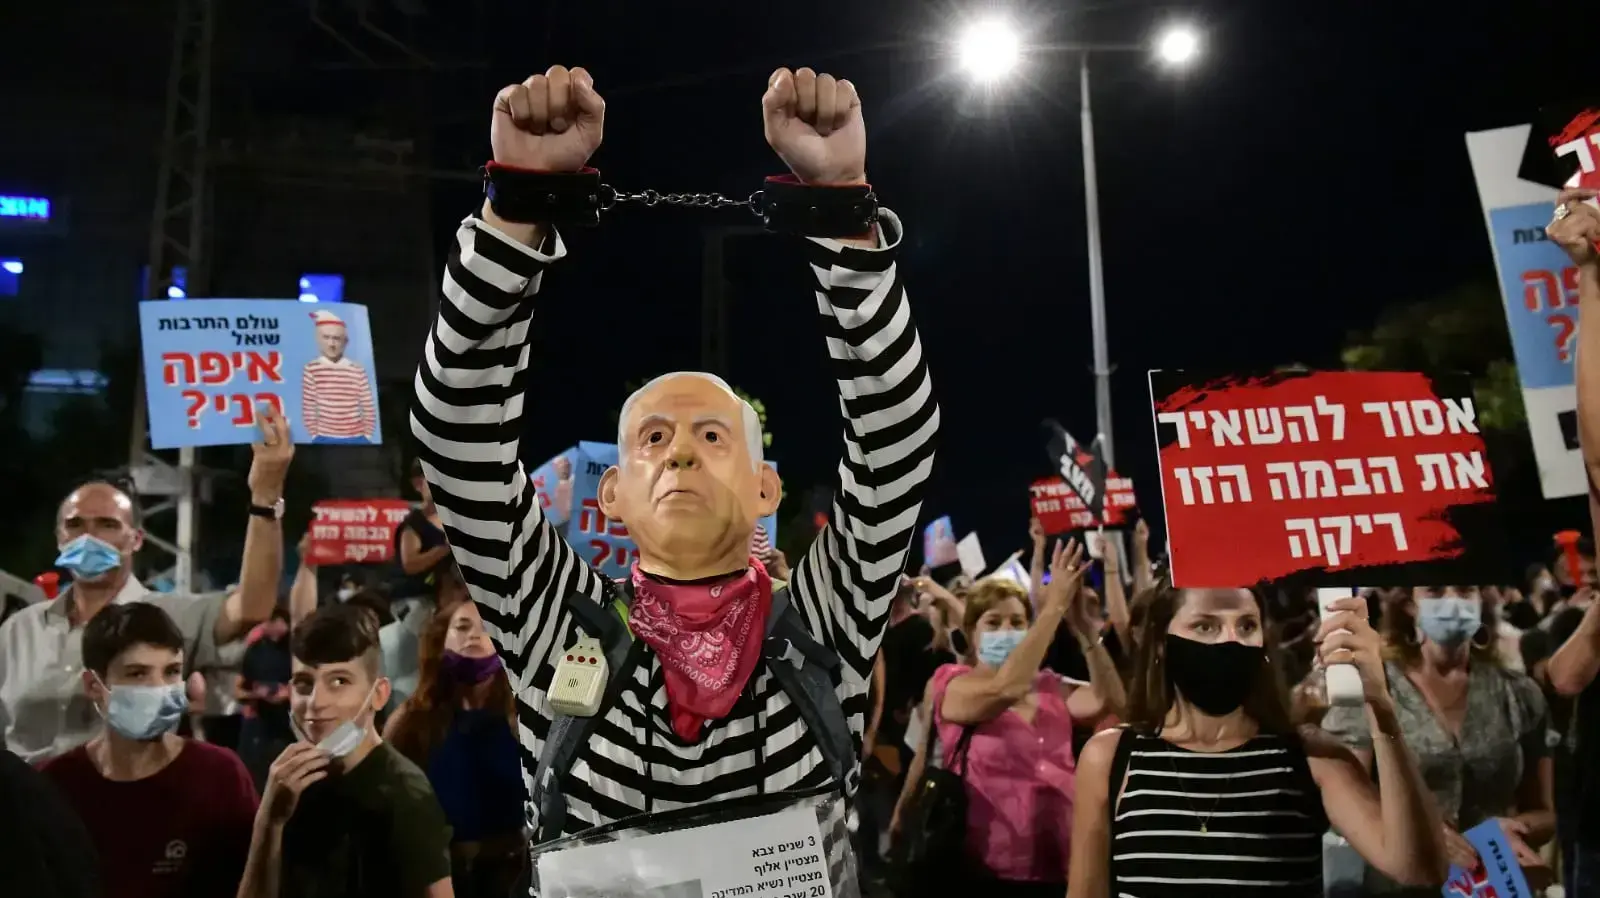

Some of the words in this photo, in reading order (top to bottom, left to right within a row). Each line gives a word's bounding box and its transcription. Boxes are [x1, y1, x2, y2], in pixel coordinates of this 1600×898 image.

[158, 317, 230, 330] התרבות
[236, 314, 279, 330] עולם
[231, 330, 281, 346] שואל
[161, 350, 284, 386] איפה
[1157, 395, 1345, 449] להשאיר
[1362, 397, 1480, 438] אסור
[1266, 456, 1404, 500] הבמה
[1414, 451, 1489, 492] את
[1174, 464, 1252, 505] הזו
[1285, 512, 1408, 566] ריקה
[777, 840, 805, 853] שנים
[807, 835, 816, 847] 3
[752, 846, 774, 858] צבא
[754, 862, 781, 877] אלוף
[784, 854, 820, 871] מצטיין
[757, 878, 784, 892] נשיא
[787, 871, 823, 888] מצטיין
[711, 884, 754, 898] המדינה
[810, 885, 825, 897] 20
